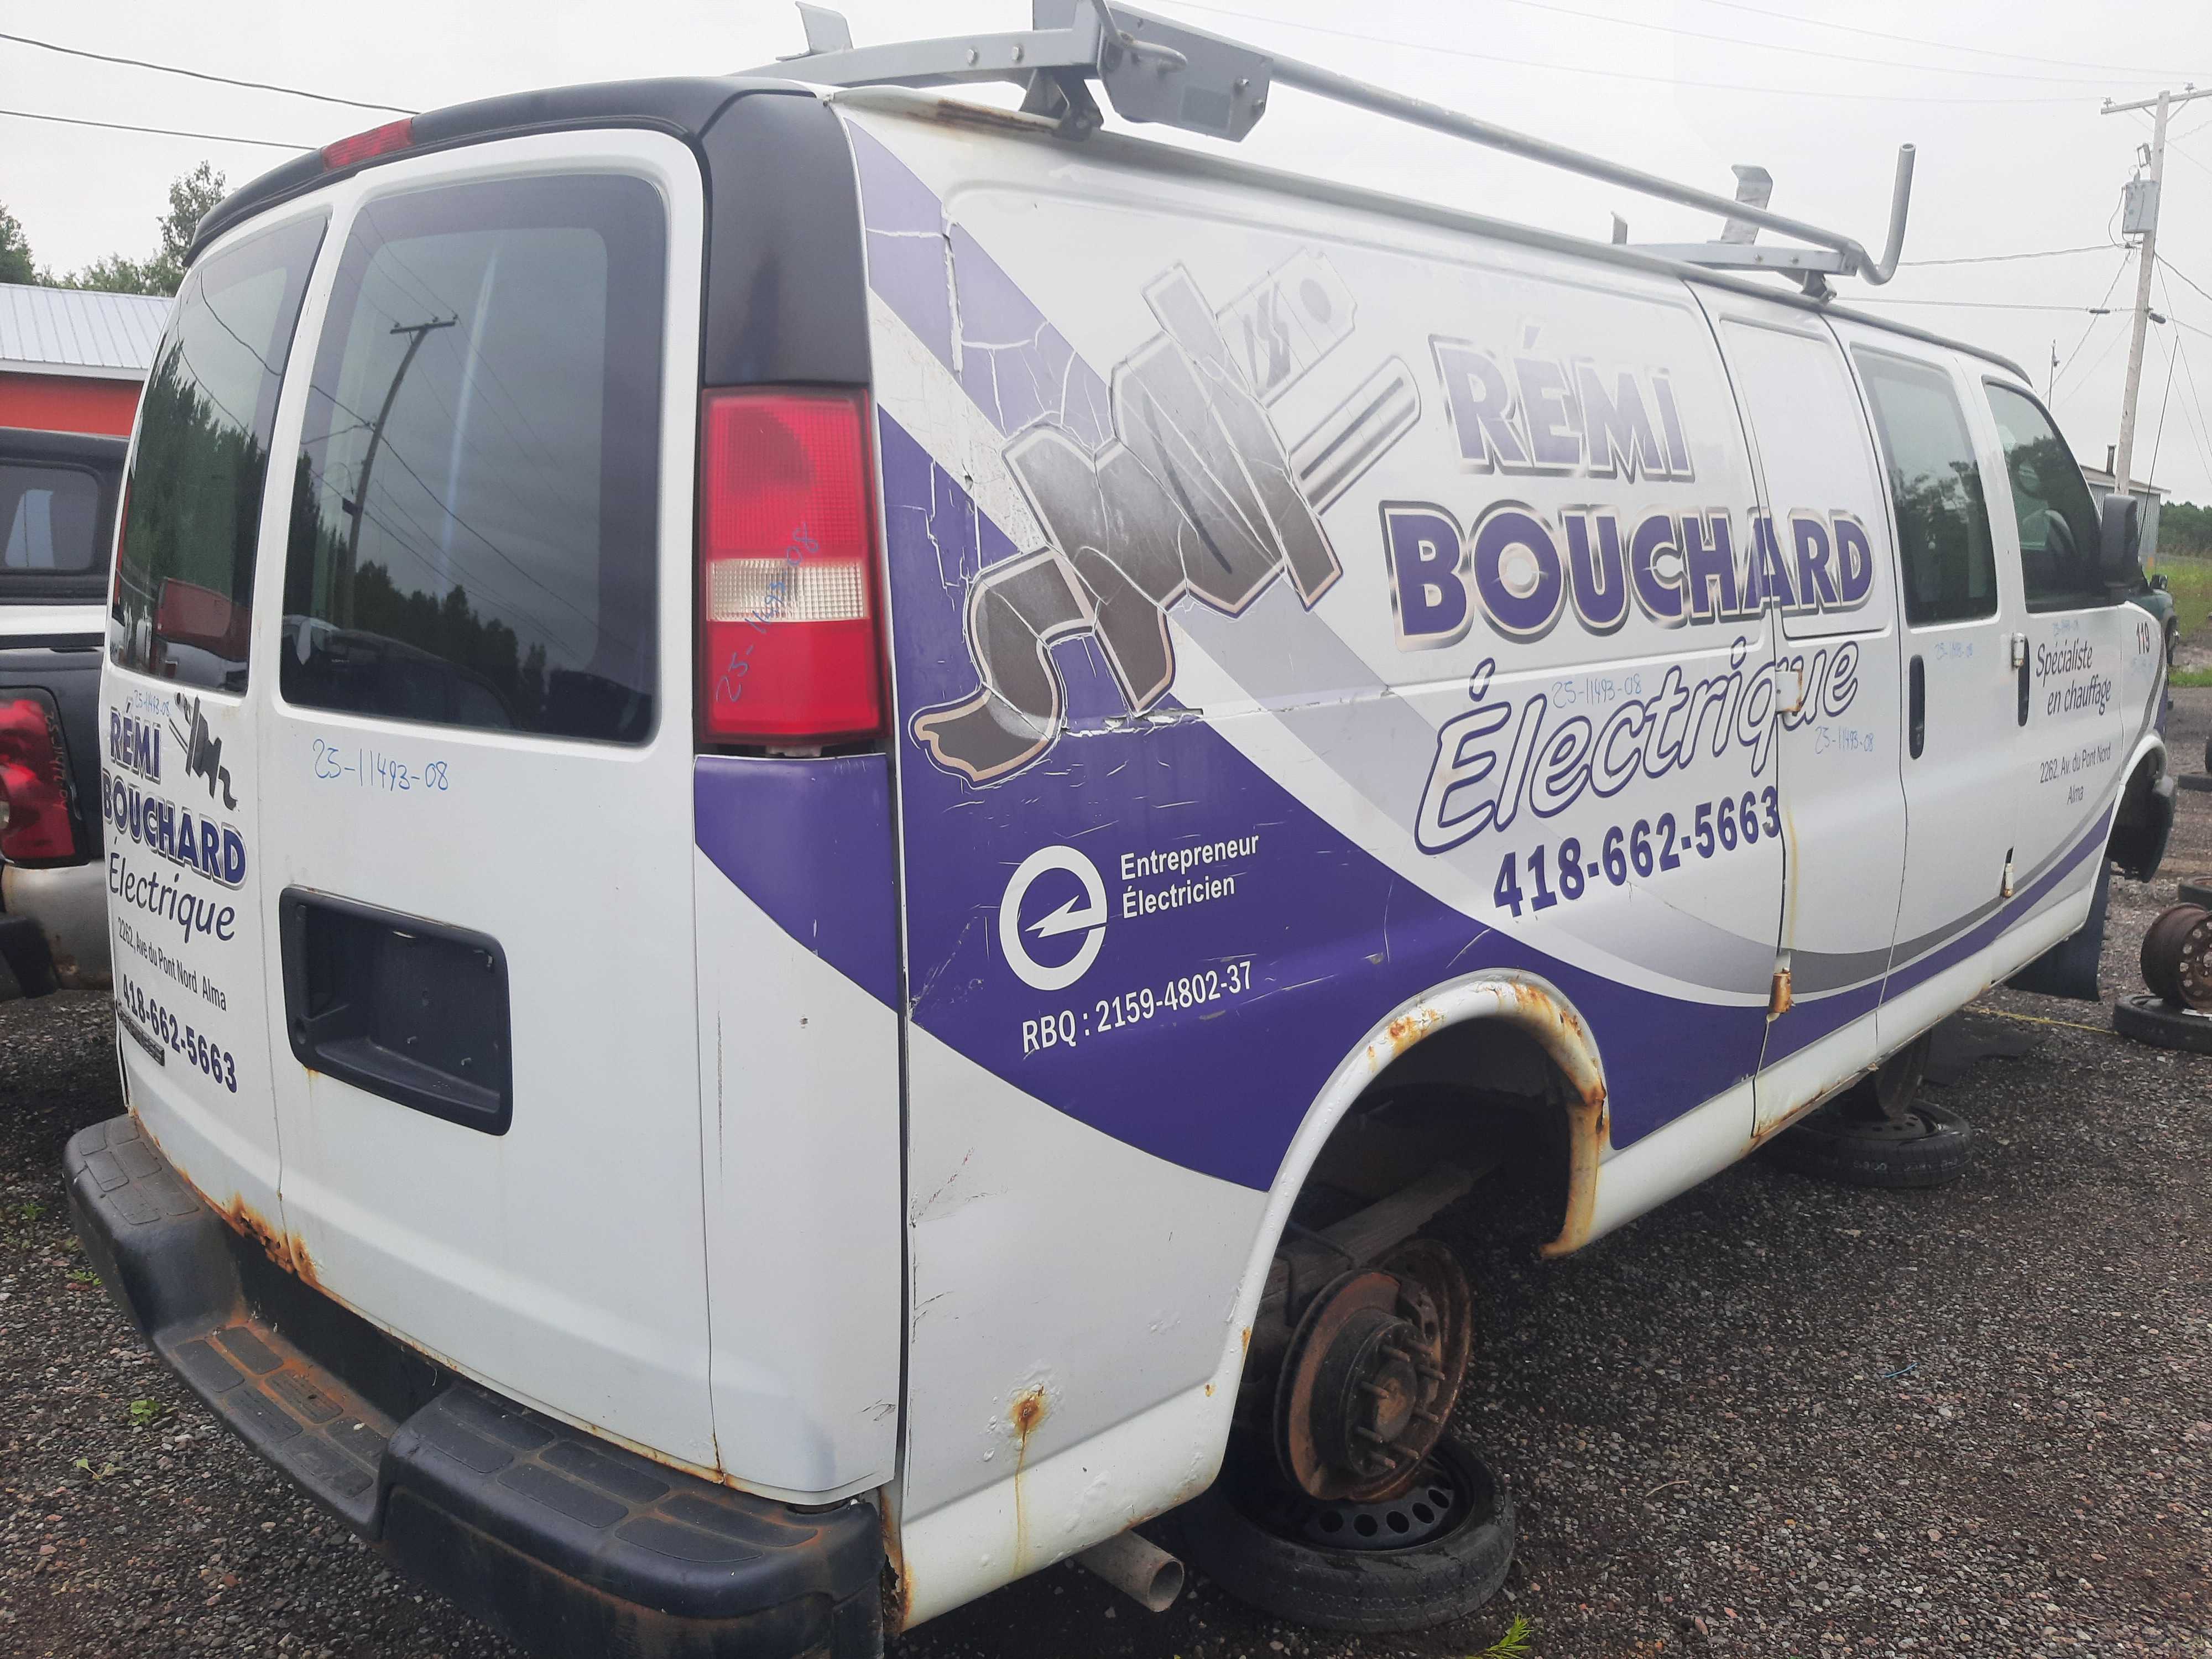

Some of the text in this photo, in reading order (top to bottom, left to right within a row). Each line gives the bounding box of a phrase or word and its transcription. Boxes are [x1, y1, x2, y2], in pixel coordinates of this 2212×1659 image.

[1428, 321, 1695, 484] RÉMI
[1378, 499, 1879, 651] BOUCHARD
[2036, 638, 2093, 688] Spécialiste
[2136, 620, 2150, 655] 119
[1552, 673, 1642, 709] 25-11493-08
[2047, 674, 2111, 716] en chauffage
[110, 696, 161, 785] RÉMI
[312, 738, 450, 792] 25-11493-08
[1414, 636, 1860, 856] Électrique
[2072, 752, 2080, 772] du
[2082, 749, 2096, 769] Pont
[2096, 742, 2111, 763] Nord
[102, 767, 248, 890] BOUCHARD
[2067, 785, 2084, 805] Alma
[109, 836, 235, 943] Électrique
[1120, 834, 1260, 881] Entrepreneur
[1493, 786, 1781, 918] 418-662-5663
[1122, 875, 1236, 919] Électricien
[136, 930, 148, 959] Ave
[148, 941, 158, 967] du
[158, 946, 177, 980] Pont
[176, 959, 198, 994] Nord
[202, 975, 227, 1012] Alma
[1021, 1009, 1076, 1053] RBQ
[1095, 961, 1253, 1034] 2159-4802-37
[123, 973, 238, 1094] 418-662-5663
